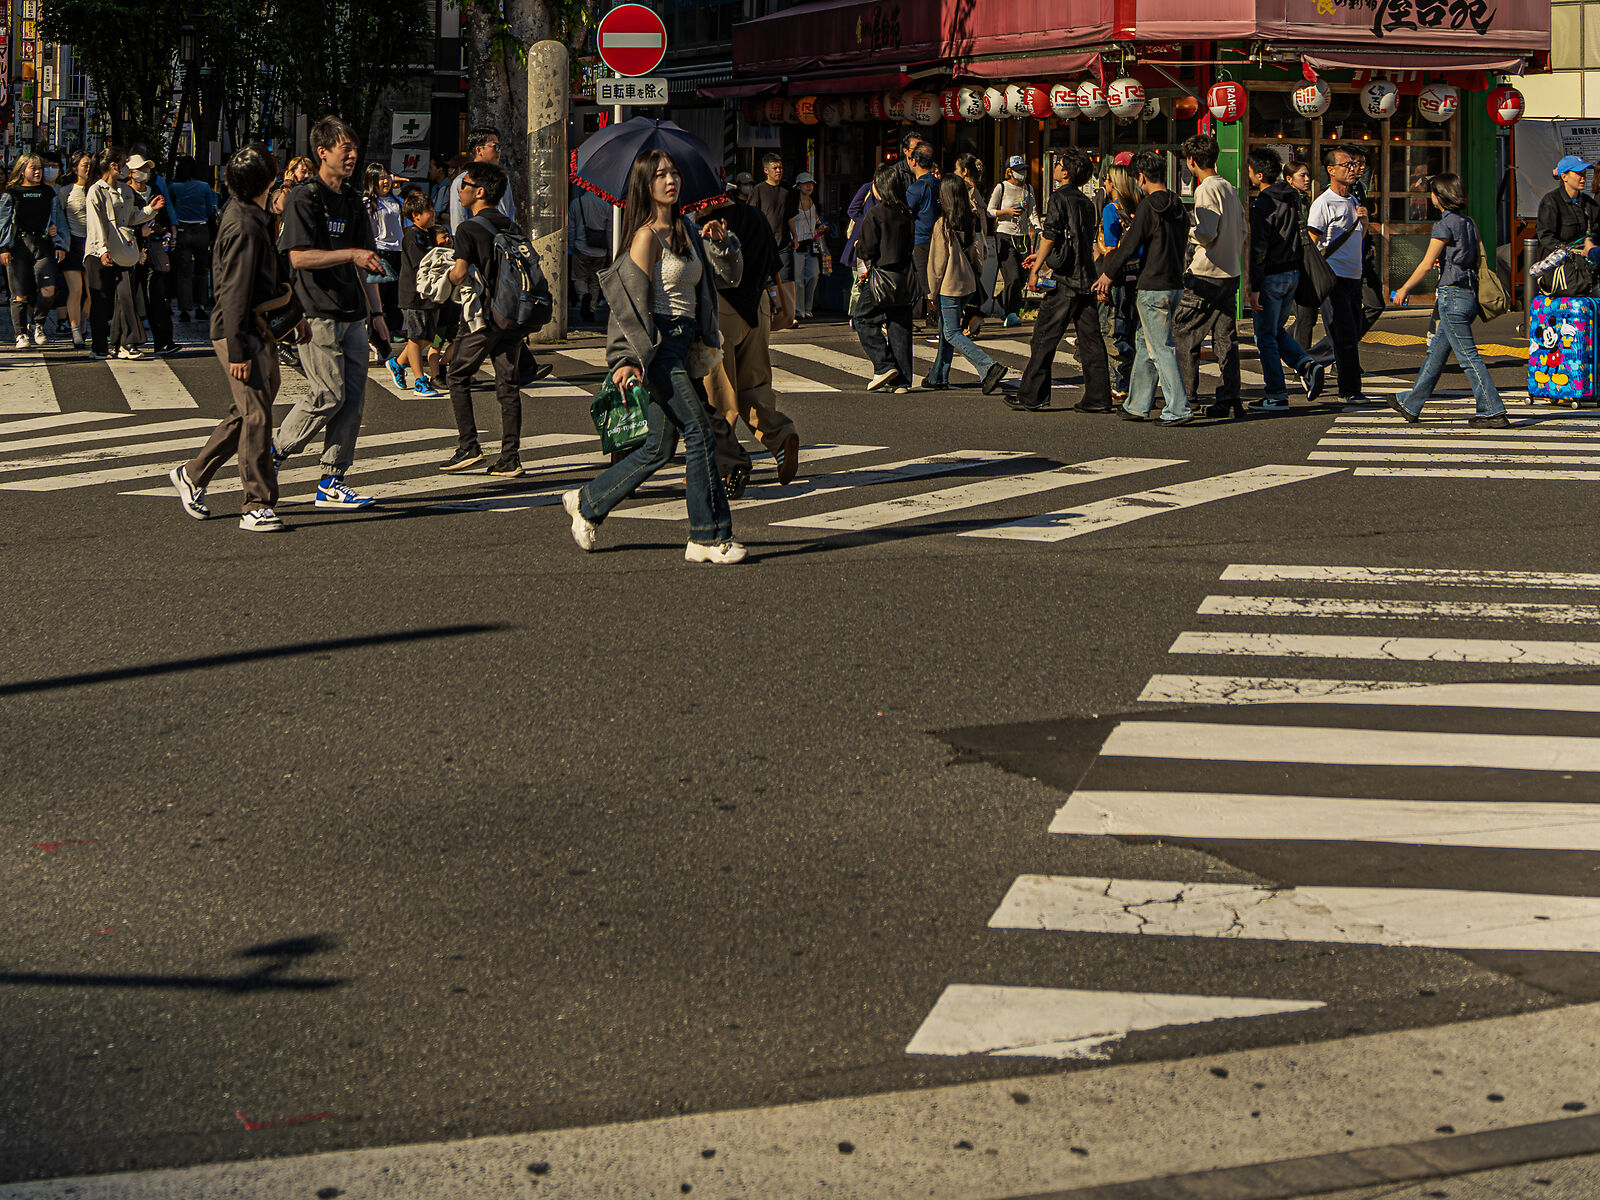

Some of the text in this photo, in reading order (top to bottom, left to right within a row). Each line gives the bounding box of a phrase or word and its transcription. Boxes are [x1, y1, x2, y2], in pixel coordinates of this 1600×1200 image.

[602, 84, 664, 99] 自転車を除く
[945, 91, 954, 117] RAMEN
[967, 91, 979, 116] くろ松
[1027, 90, 1036, 115] RAMEN
[1226, 86, 1235, 117] RAMEN
[1420, 97, 1439, 111] RS
